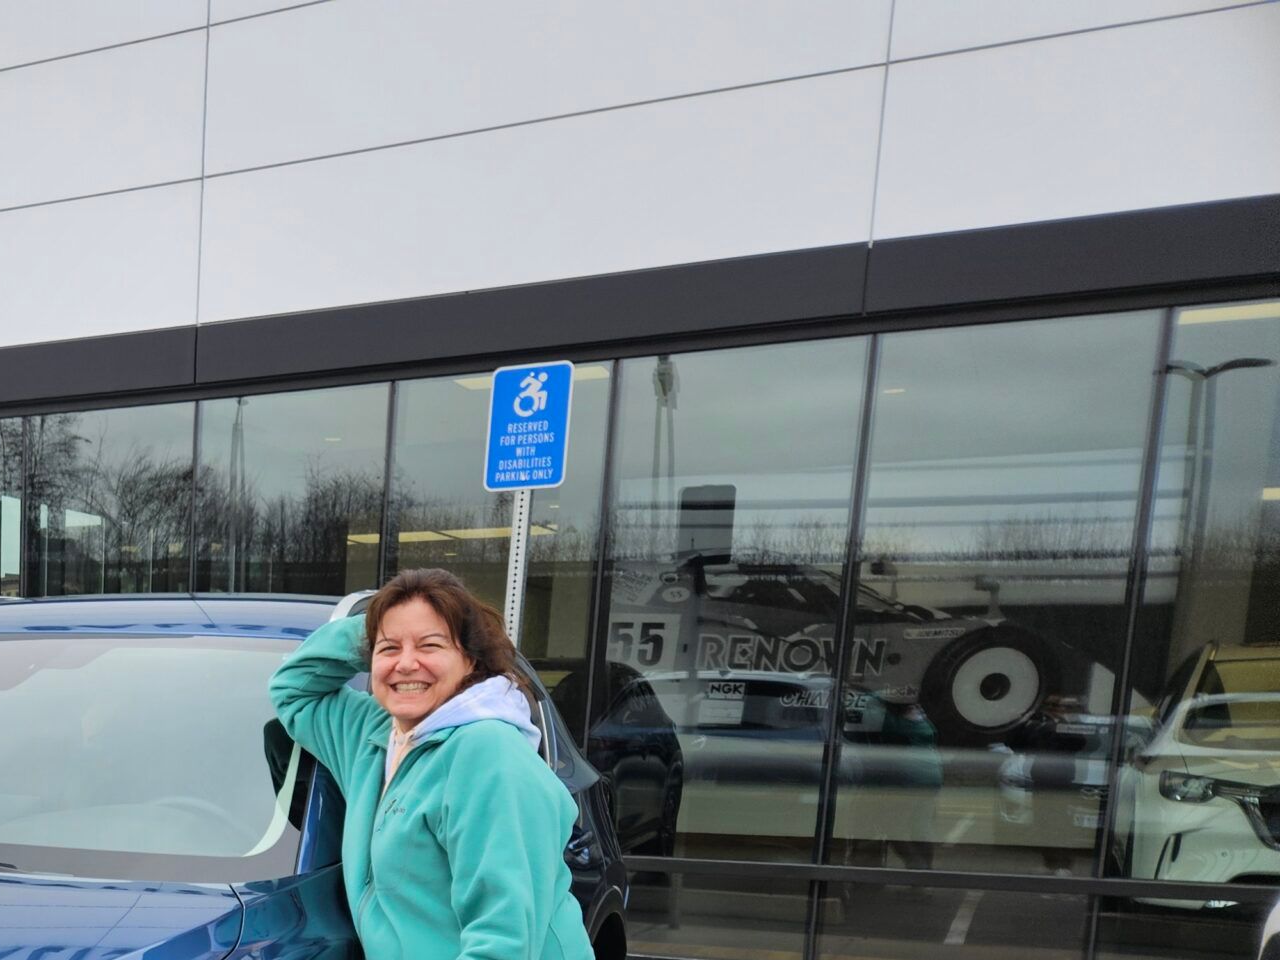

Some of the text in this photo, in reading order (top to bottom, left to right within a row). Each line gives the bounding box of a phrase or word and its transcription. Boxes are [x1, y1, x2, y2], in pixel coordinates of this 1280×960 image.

[508, 420, 549, 434] RESERVED
[500, 432, 554, 446] FOR PERSONS
[515, 446, 536, 457] WITH
[498, 456, 552, 470] DISABILITIES
[495, 468, 554, 482] PARKING ONLY
[606, 621, 666, 667] 55
[710, 683, 744, 695] NGK
